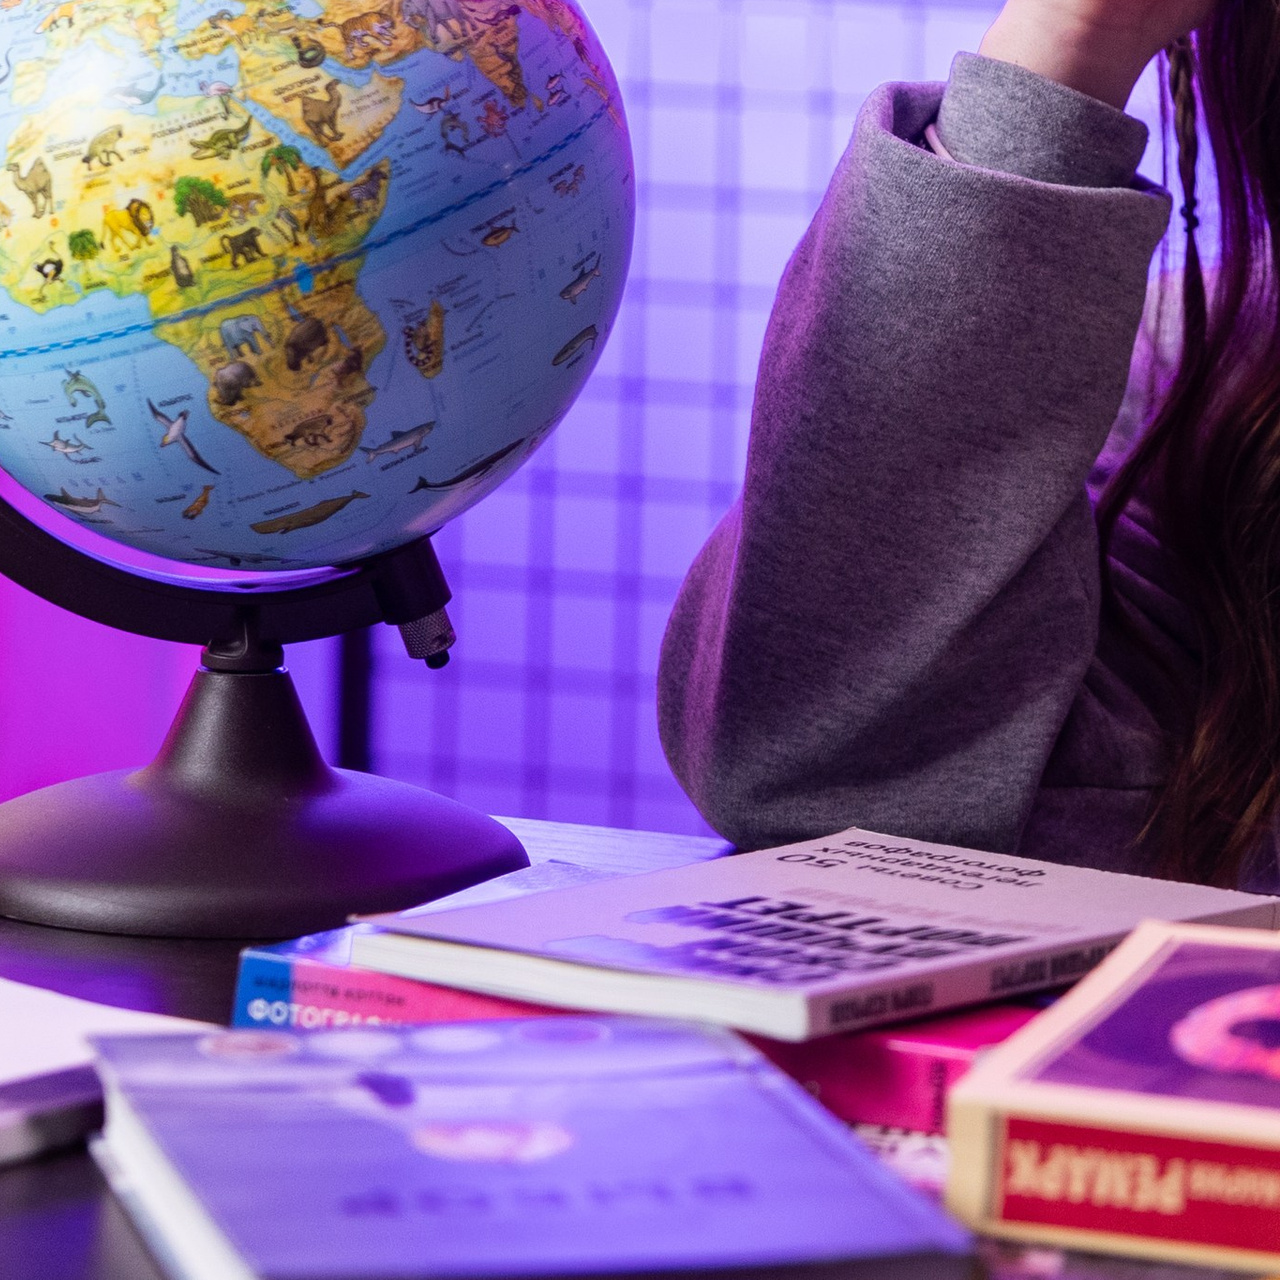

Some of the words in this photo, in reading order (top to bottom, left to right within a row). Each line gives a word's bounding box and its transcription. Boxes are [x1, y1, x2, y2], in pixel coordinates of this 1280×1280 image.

[776, 852, 848, 869] 50
[813, 845, 1043, 888] легендарных
[843, 840, 1048, 878] фотографов
[855, 863, 985, 892] Советы
[247, 997, 404, 1029] ФОТОГРА
